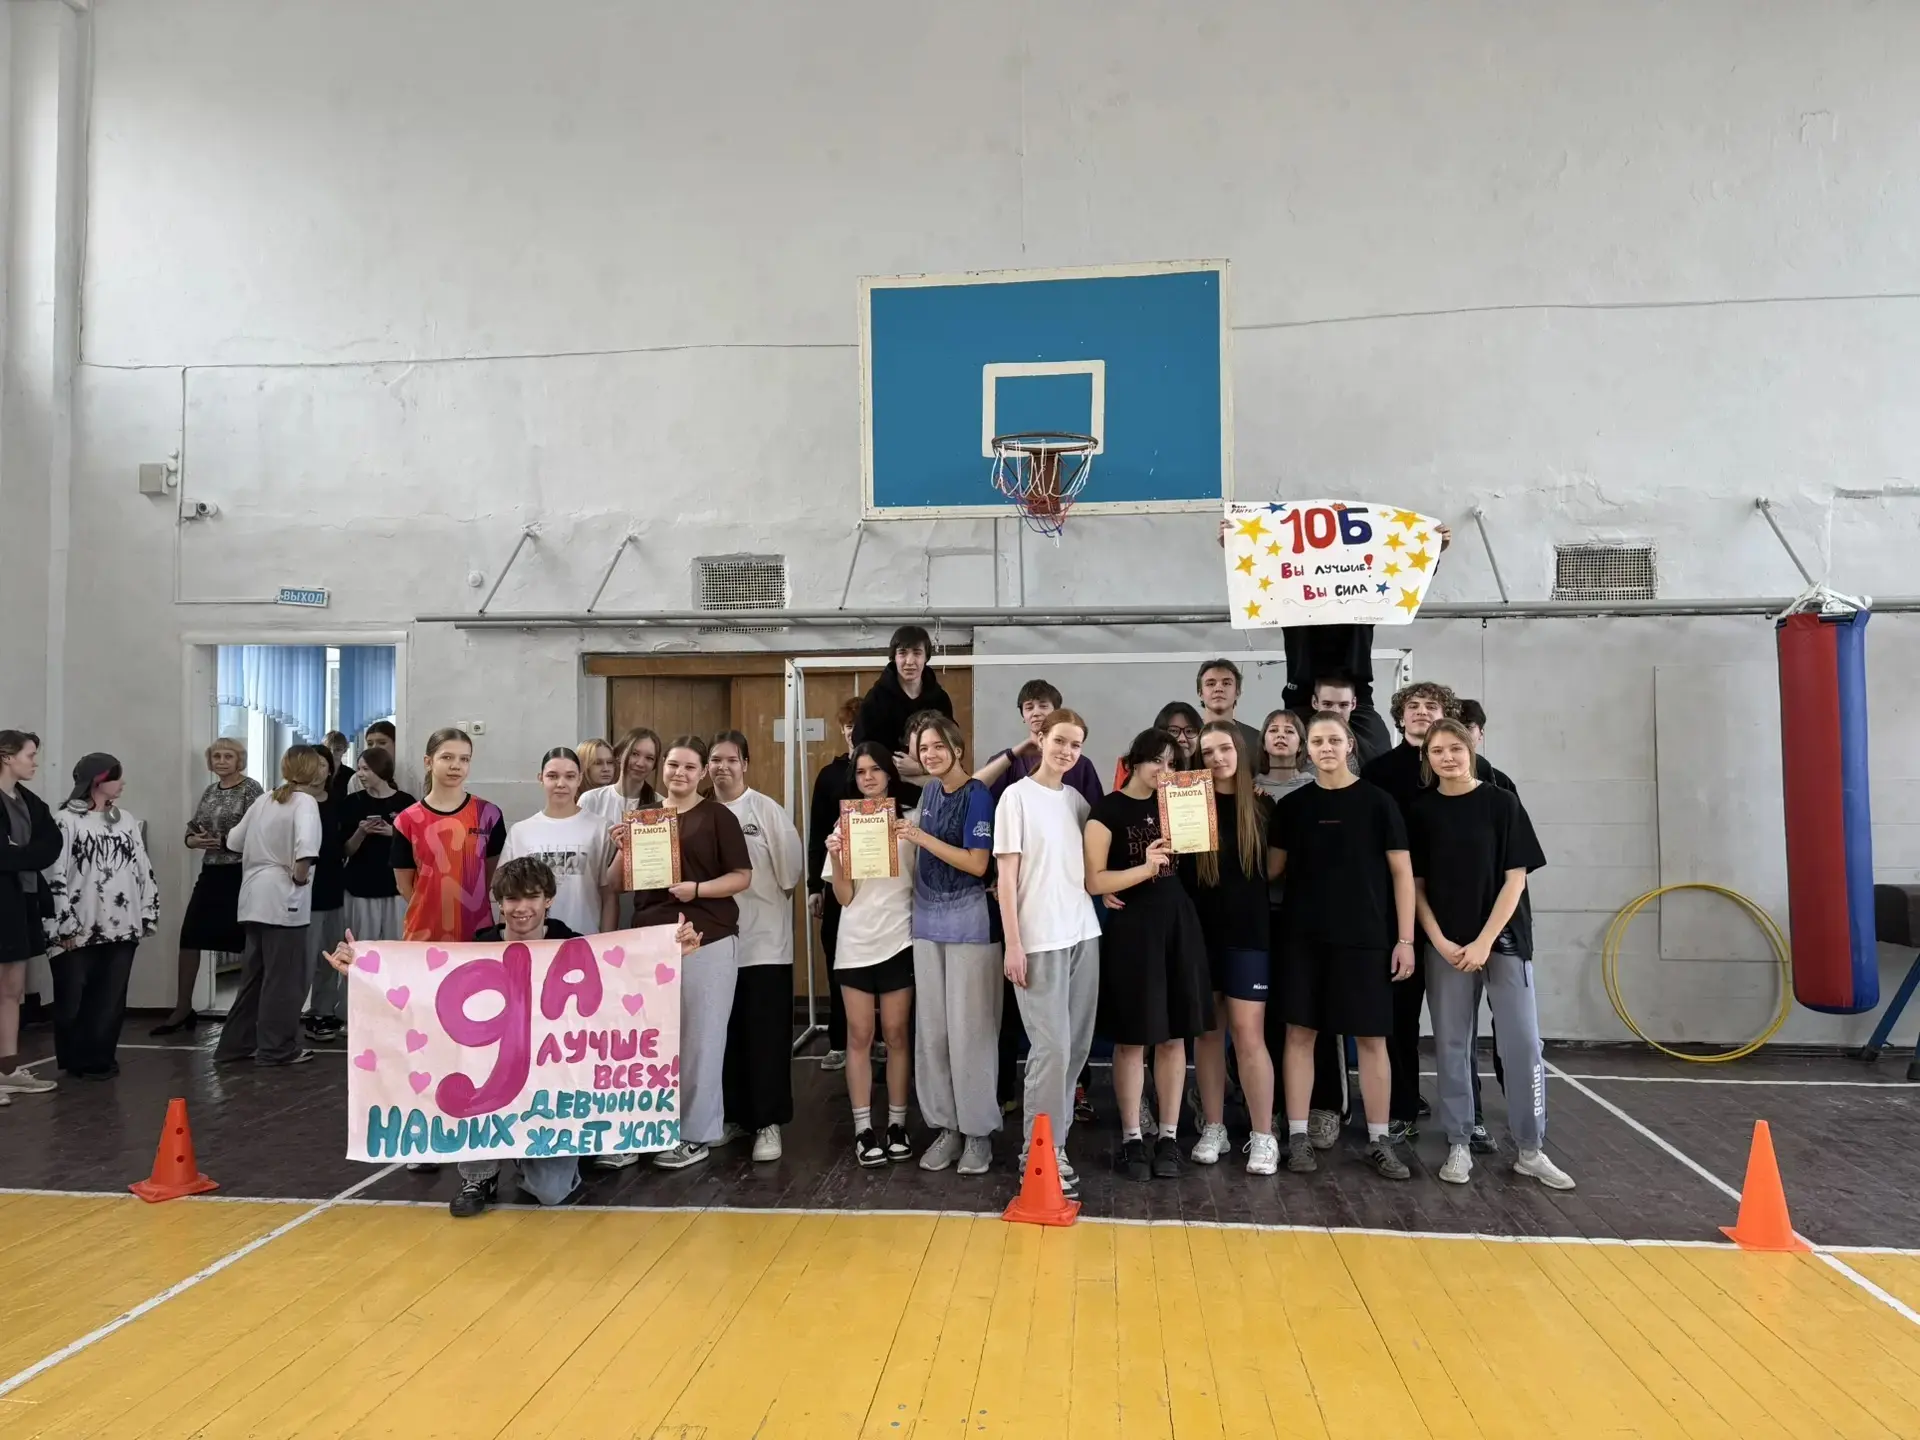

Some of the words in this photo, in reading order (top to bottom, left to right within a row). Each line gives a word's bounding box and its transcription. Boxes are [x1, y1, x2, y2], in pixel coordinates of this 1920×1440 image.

[1280, 507, 1373, 554] 10Б
[283, 590, 323, 604] ВЫХОД
[1335, 584, 1368, 597] СИЛА
[1169, 789, 1203, 799] ГРАМОТА
[633, 826, 667, 835] ГРАМОТА
[852, 817, 885, 825] ГРАМОТА
[536, 1028, 660, 1067] ЛУЧШЕ
[593, 1054, 680, 1090] ВСЕХ!
[1531, 1063, 1543, 1117] genius
[366, 1105, 519, 1158] НАШИХ
[520, 1088, 675, 1122] ДЕВЧОНОК
[525, 1120, 612, 1156] ЖДЕТ
[613, 1118, 680, 1150] УСПЕХ
